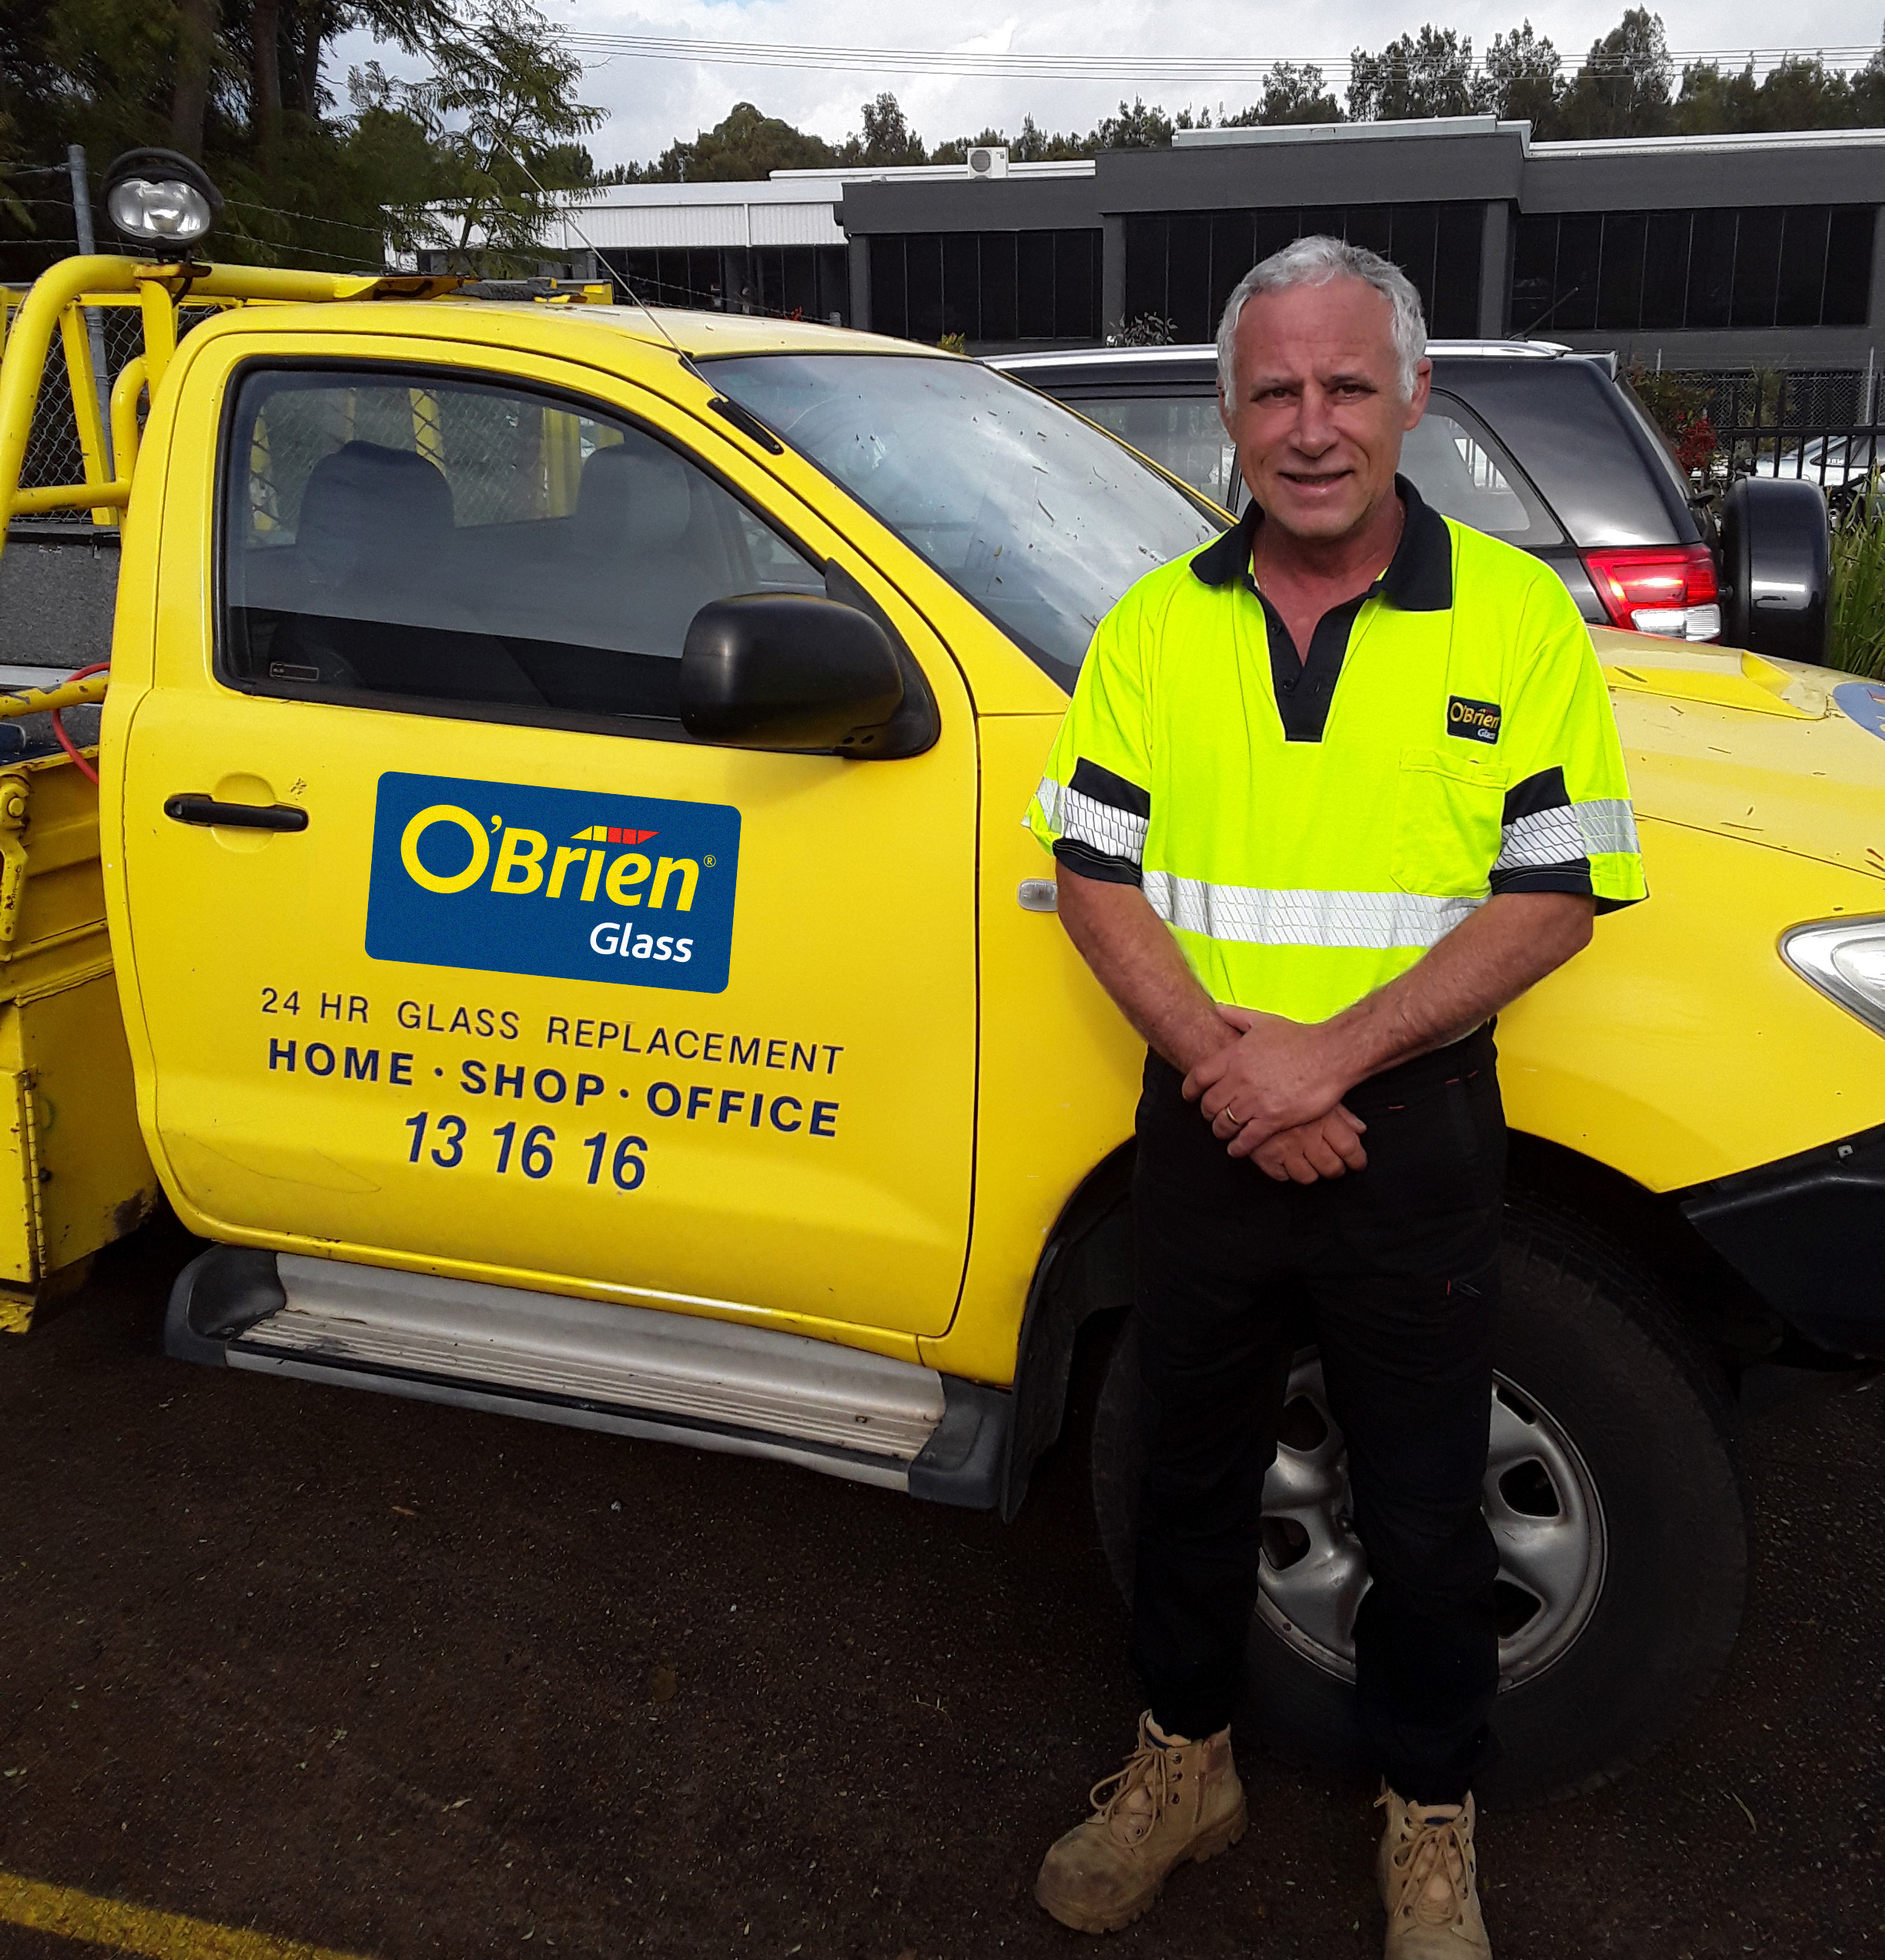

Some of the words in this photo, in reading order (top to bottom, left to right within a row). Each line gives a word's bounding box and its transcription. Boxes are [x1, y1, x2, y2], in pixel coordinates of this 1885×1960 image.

[1450, 702, 1500, 729] O'Brien
[589, 922, 695, 963] Glass
[260, 987, 301, 1017] 24
[320, 991, 370, 1024] HR
[397, 1000, 521, 1040] GLASS
[546, 1014, 845, 1076] REPLACEMENT
[268, 1037, 414, 1087] HOME
[459, 1059, 605, 1107] SHOP
[646, 1081, 841, 1138] OFFICE
[403, 1111, 467, 1169] 13
[491, 1121, 557, 1180] 16
[582, 1131, 649, 1191] 16
